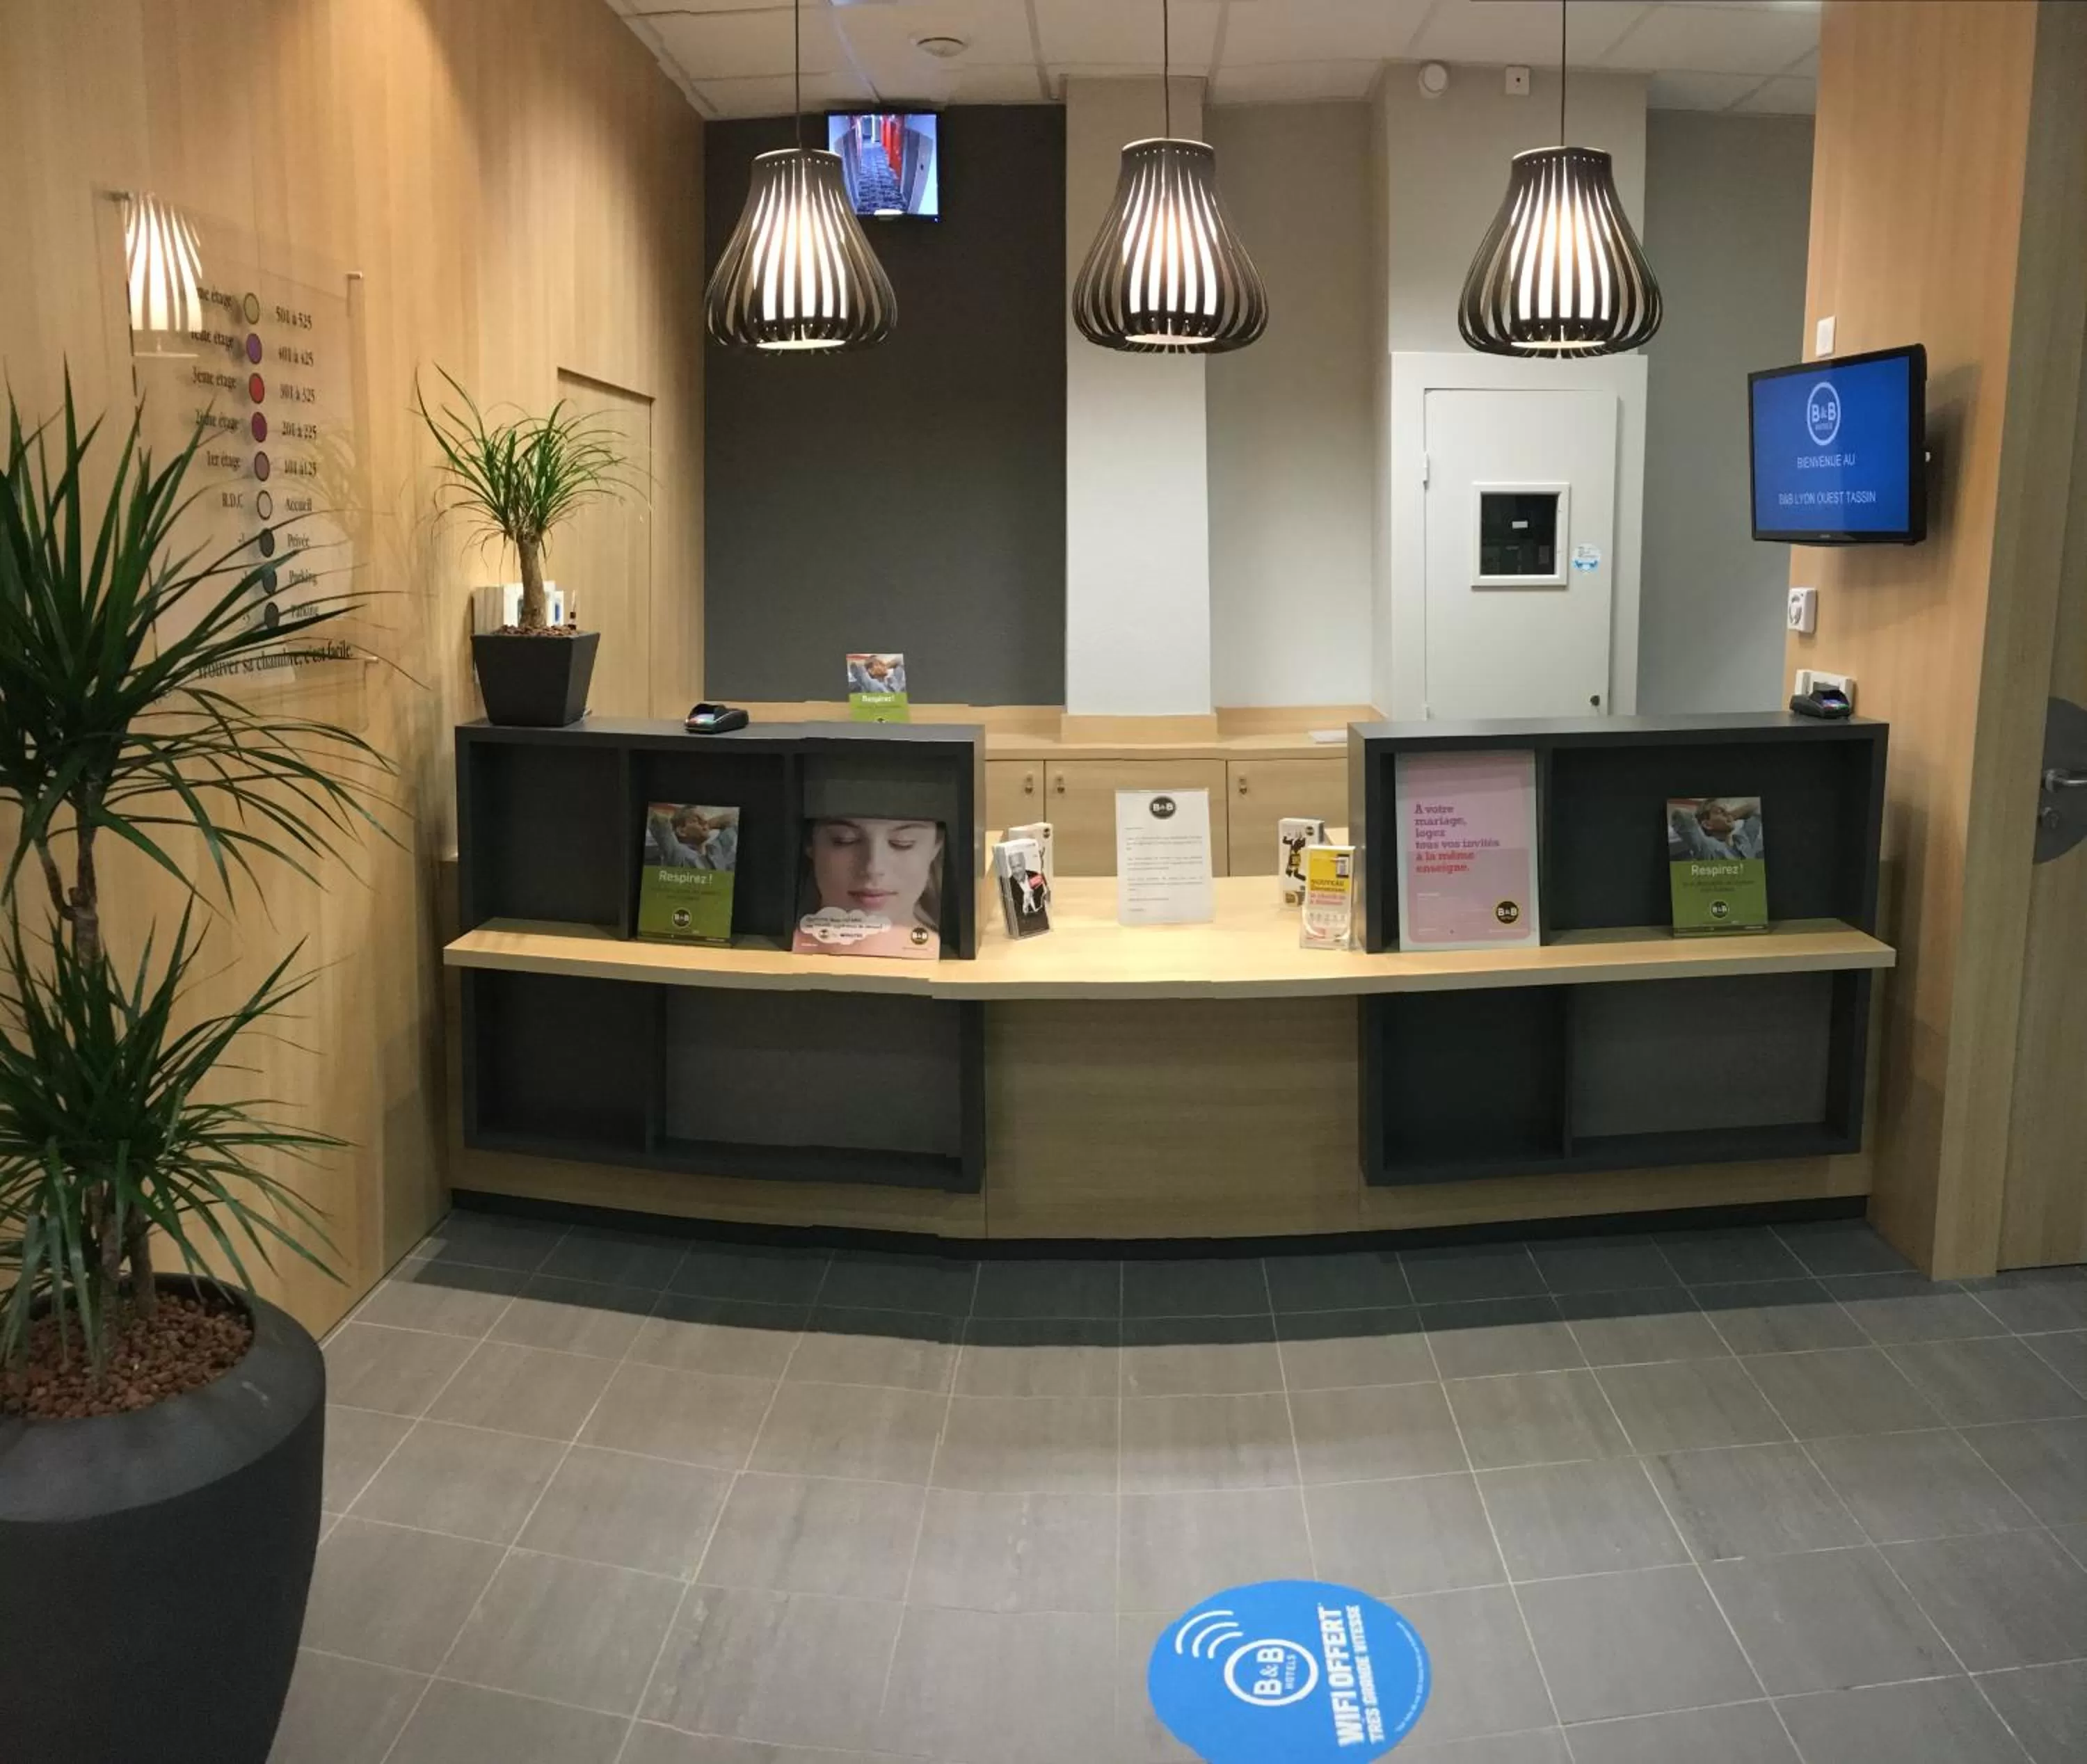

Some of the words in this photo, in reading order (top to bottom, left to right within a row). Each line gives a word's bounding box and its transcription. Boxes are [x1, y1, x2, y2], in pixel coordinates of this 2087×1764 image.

[1811, 401, 1837, 424] B&B
[1797, 454, 1841, 468] BIENVENUE
[1843, 453, 1855, 467] AU
[286, 497, 312, 512] Accueil
[1778, 492, 1793, 505] B&B
[1794, 491, 1816, 504] LYON
[1816, 490, 1844, 504] OUEST
[1844, 490, 1876, 504] TASSIN
[1425, 804, 1454, 814] votre
[1416, 841, 1439, 849] tous
[1441, 840, 1460, 849] vos
[1425, 851, 1436, 860] la
[658, 870, 707, 885] Respirez
[1691, 863, 1738, 877] Respirez
[1253, 1646, 1285, 1696] B&B
[1284, 1653, 1297, 1690] HOTELS
[1330, 1690, 1365, 1747] WIFI
